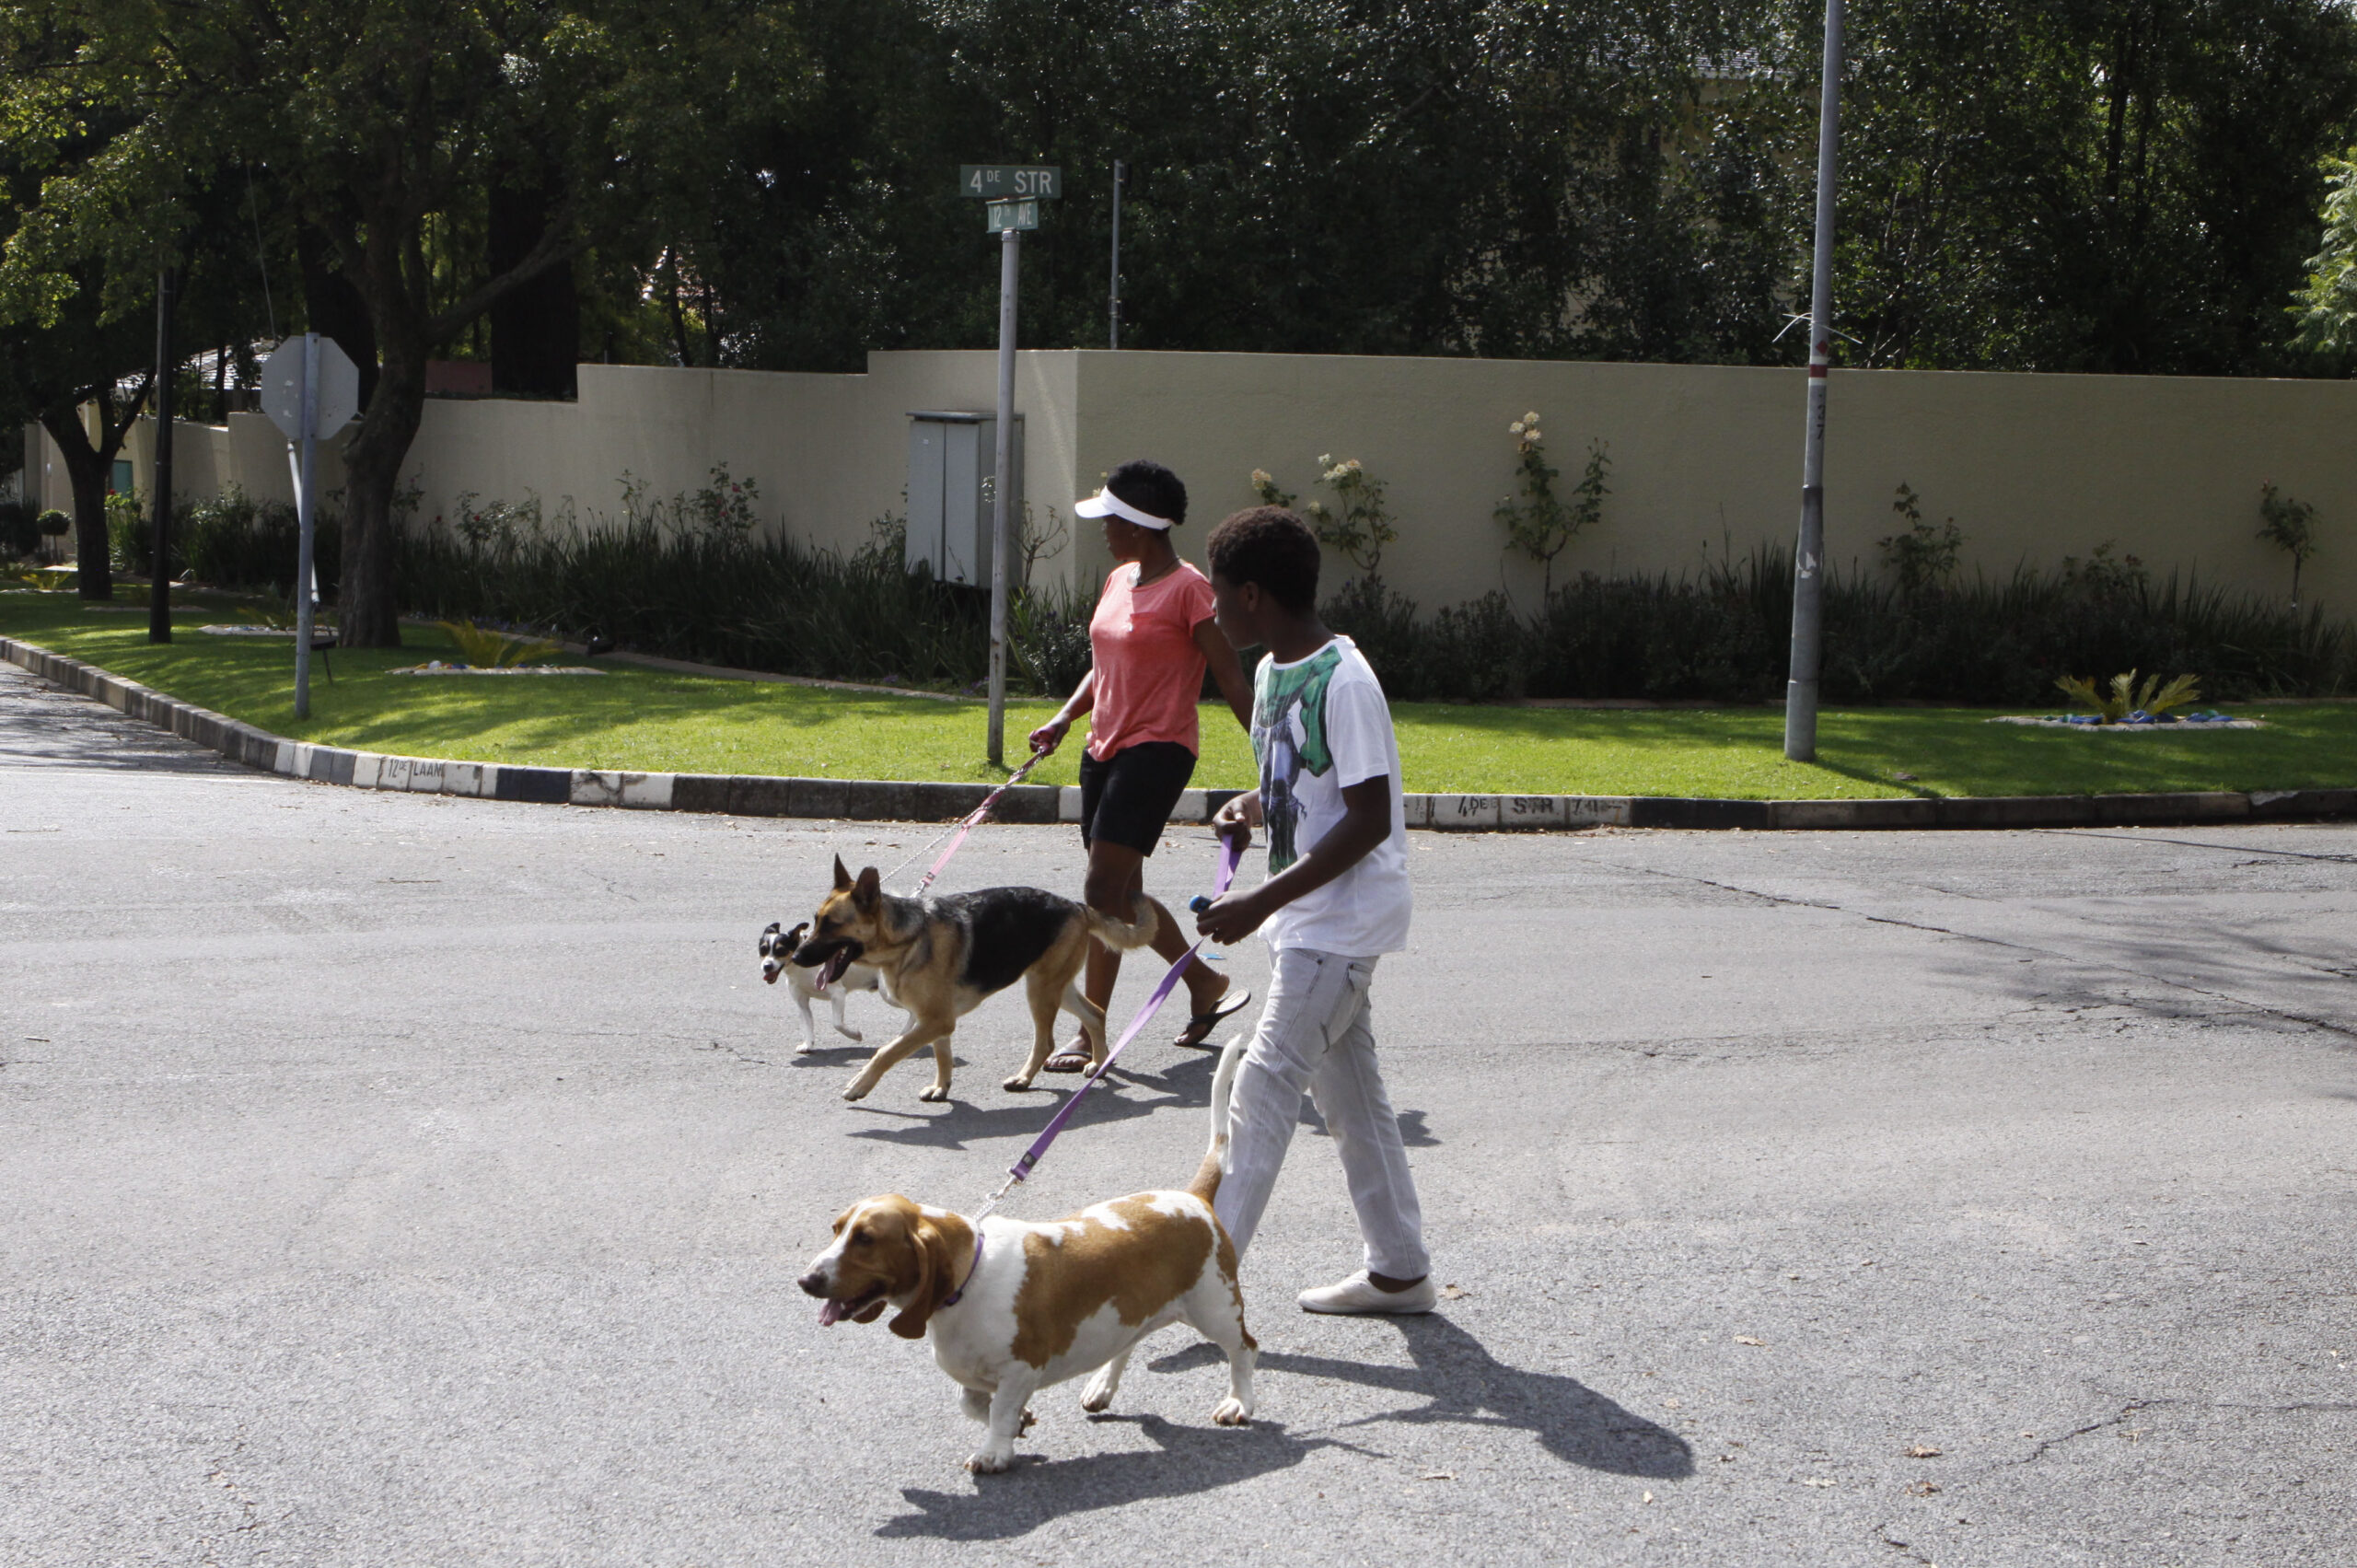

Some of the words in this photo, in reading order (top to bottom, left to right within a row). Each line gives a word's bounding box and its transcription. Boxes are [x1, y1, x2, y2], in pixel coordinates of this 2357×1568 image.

[970, 170, 1001, 192] 4DE
[1015, 170, 1051, 193] STR
[413, 761, 442, 778] LAAN
[1511, 796, 1555, 815] STR
